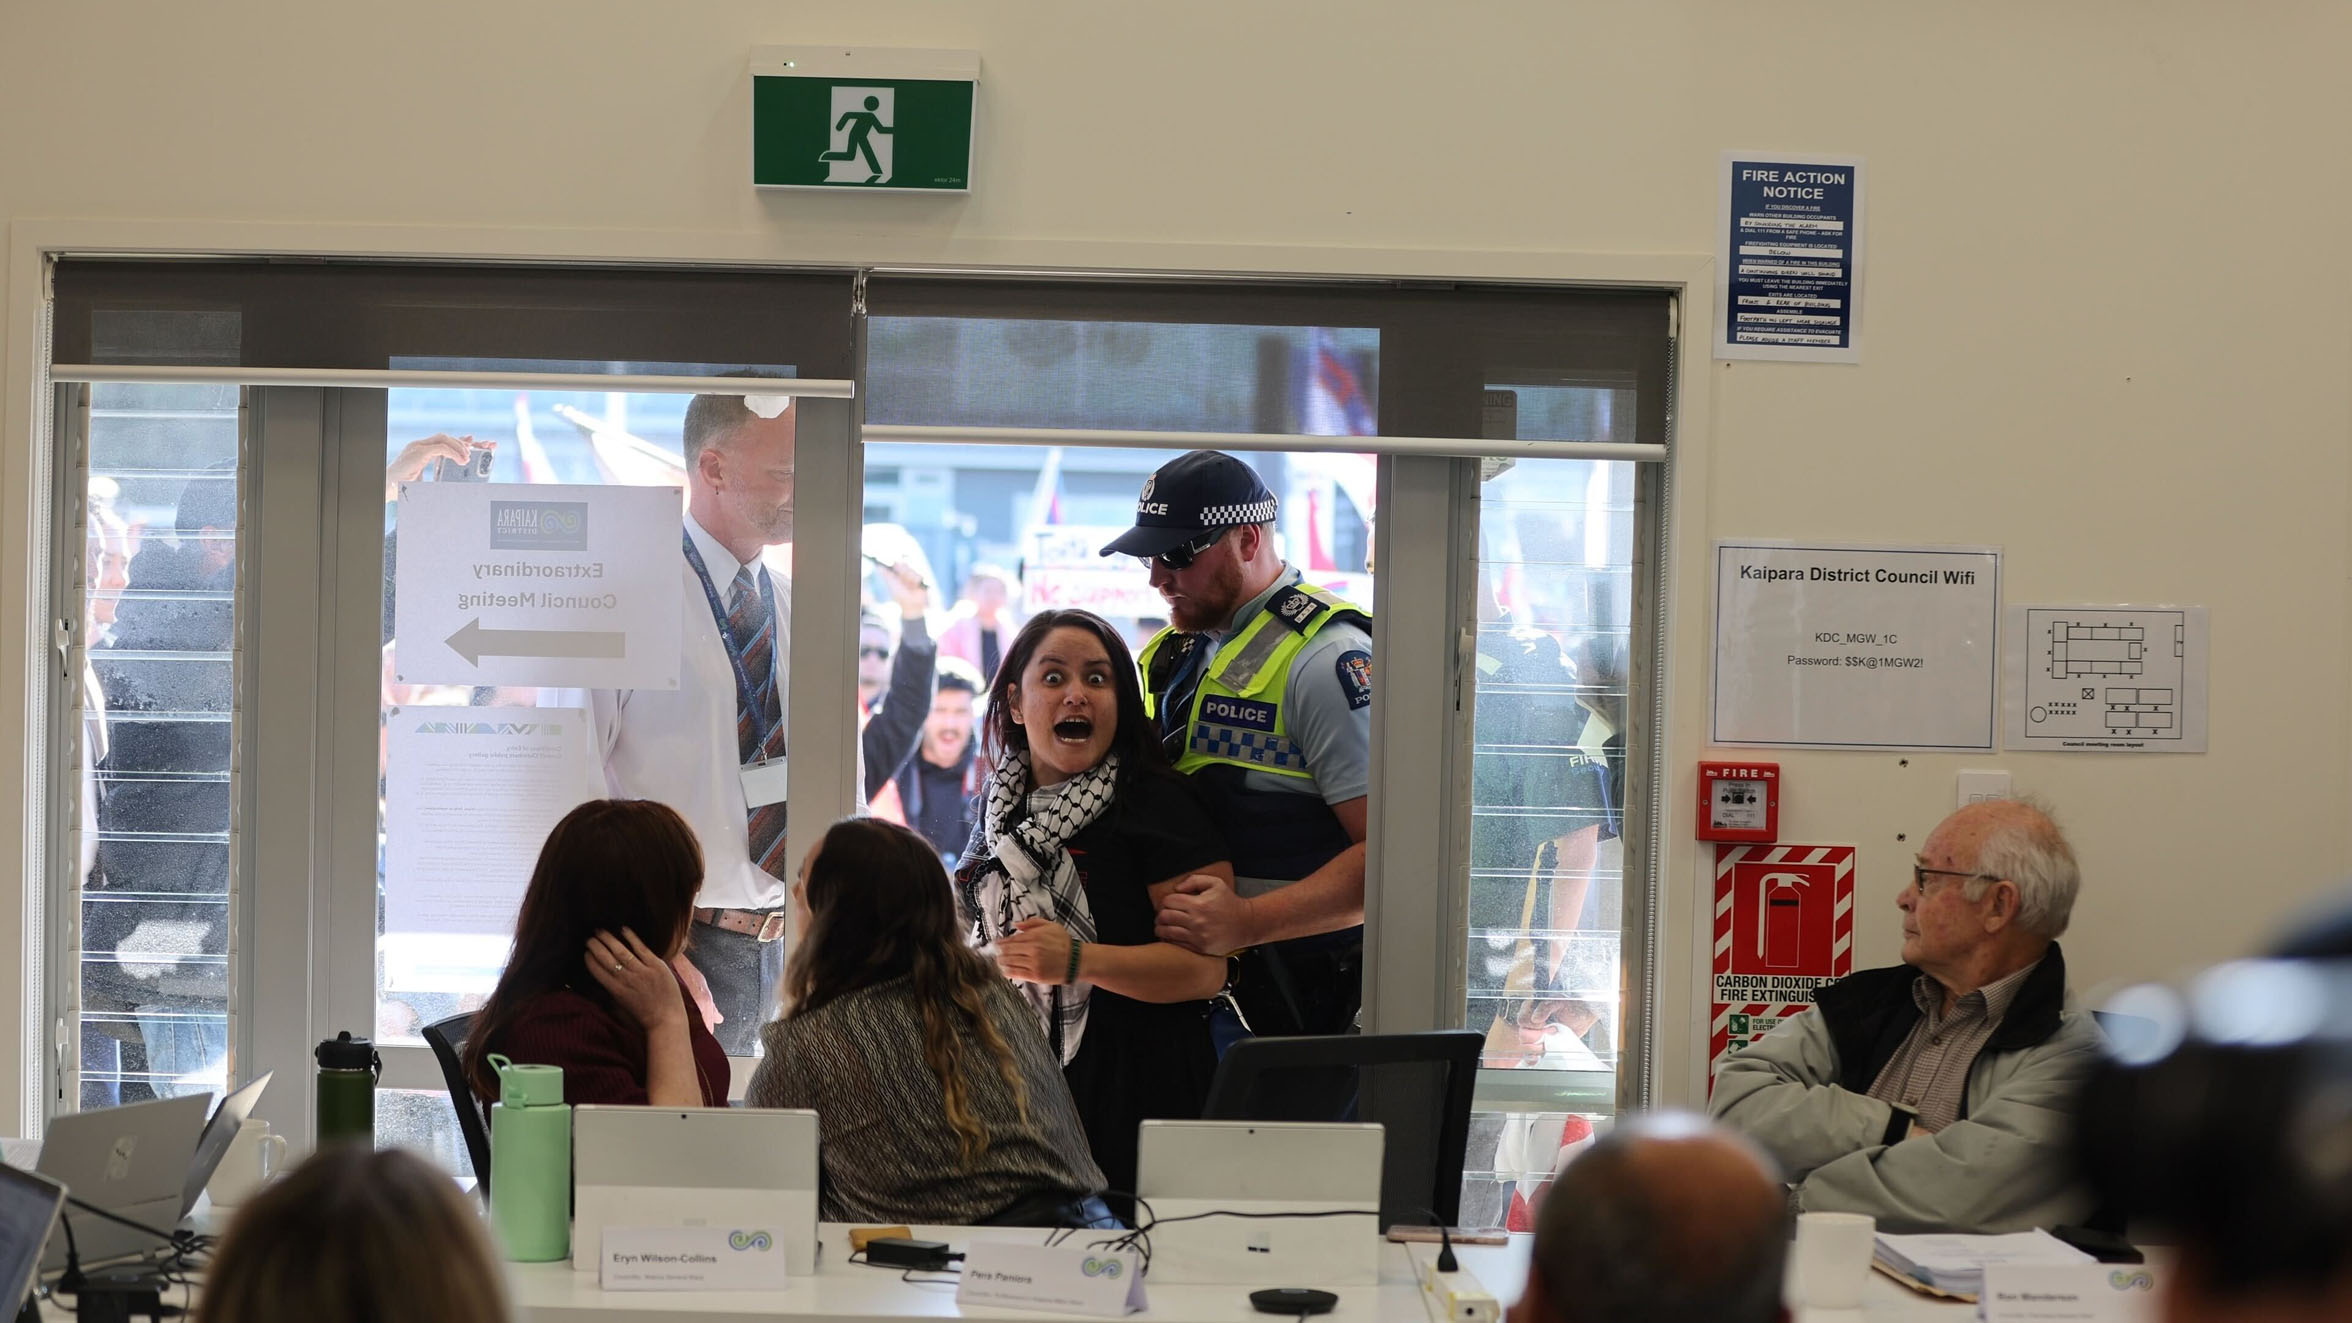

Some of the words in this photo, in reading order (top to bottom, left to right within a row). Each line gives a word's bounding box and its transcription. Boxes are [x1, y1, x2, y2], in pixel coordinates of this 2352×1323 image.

[1742, 170, 1779, 182] FIRE
[1784, 172, 1845, 184] ACTION
[1763, 187, 1824, 199] NOTICE
[1137, 503, 1168, 516] OLICE
[1740, 565, 1804, 584] Kaipara
[1810, 567, 1870, 583] District
[1876, 568, 1938, 585] Council
[1944, 570, 1976, 585] Wifi
[1815, 632, 1898, 647] KDC_MGW_1C
[1787, 655, 1842, 666] Password:
[1845, 656, 1924, 669] $$K@1MGW2!
[1206, 702, 1268, 723] POLICE
[1723, 769, 1758, 777] FIRE
[1716, 975, 1768, 988] CARBON
[1772, 977, 1822, 989] DIOXIDE
[1721, 989, 1748, 1001] FIRE
[613, 1253, 638, 1265] Eryn
[641, 1254, 717, 1264] Wilson-Collins
